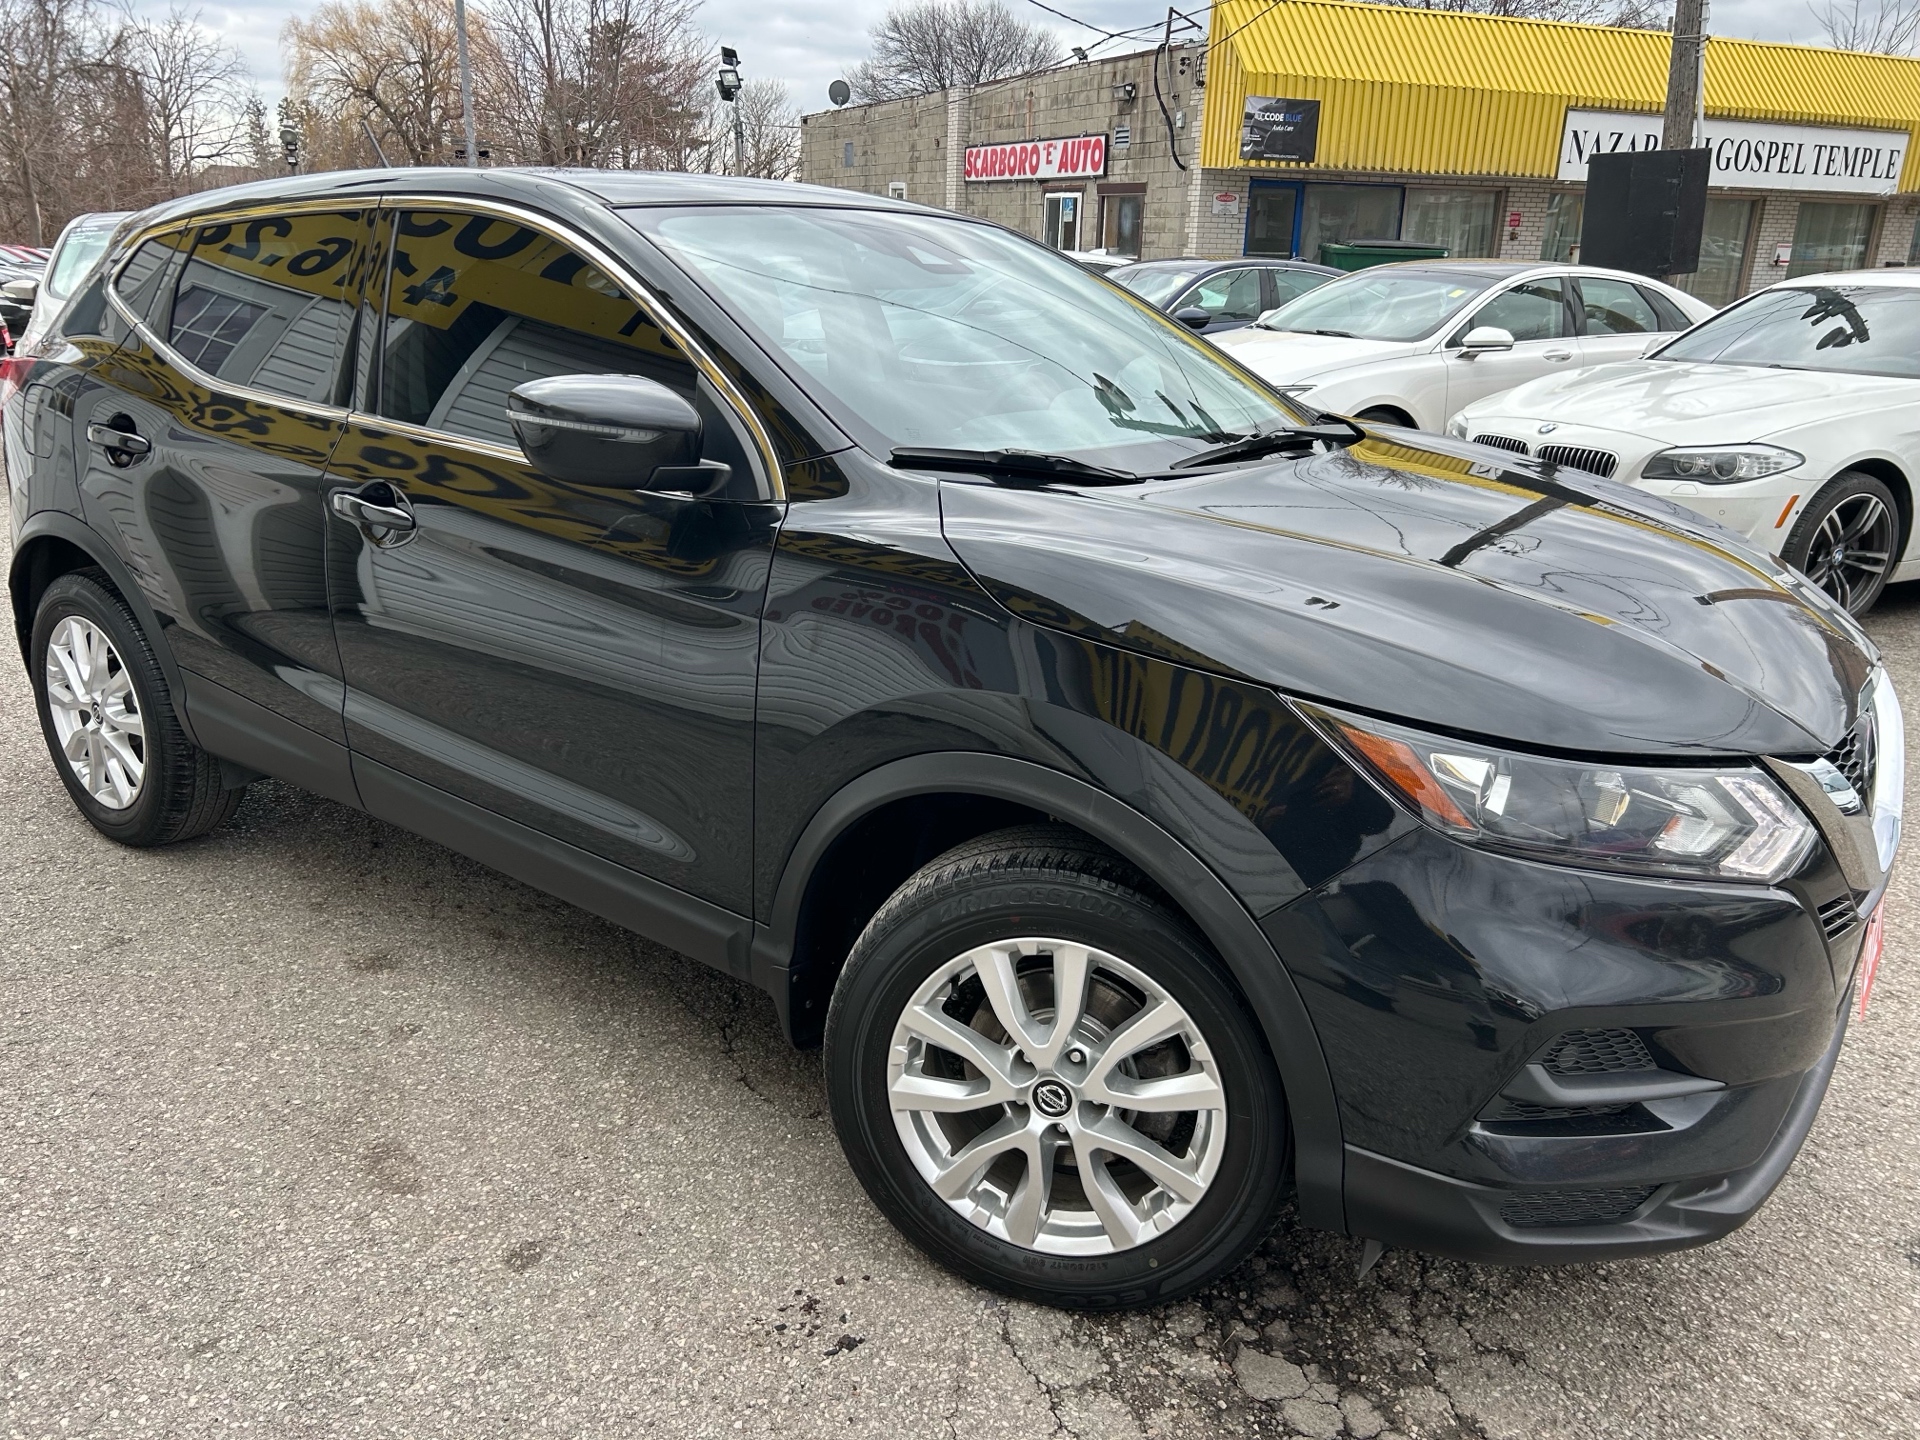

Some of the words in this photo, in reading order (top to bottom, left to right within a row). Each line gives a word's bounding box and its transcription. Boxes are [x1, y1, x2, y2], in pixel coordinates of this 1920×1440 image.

[1265, 112, 1284, 121] CODE
[1285, 113, 1302, 122] BLUE
[965, 144, 1040, 179] SCARBORO
[1057, 137, 1104, 173] AUTO
[1715, 137, 1807, 175] GOSPEL
[1812, 144, 1901, 180] TEMPLE
[1039, 1089, 1065, 1109] NISSAN
